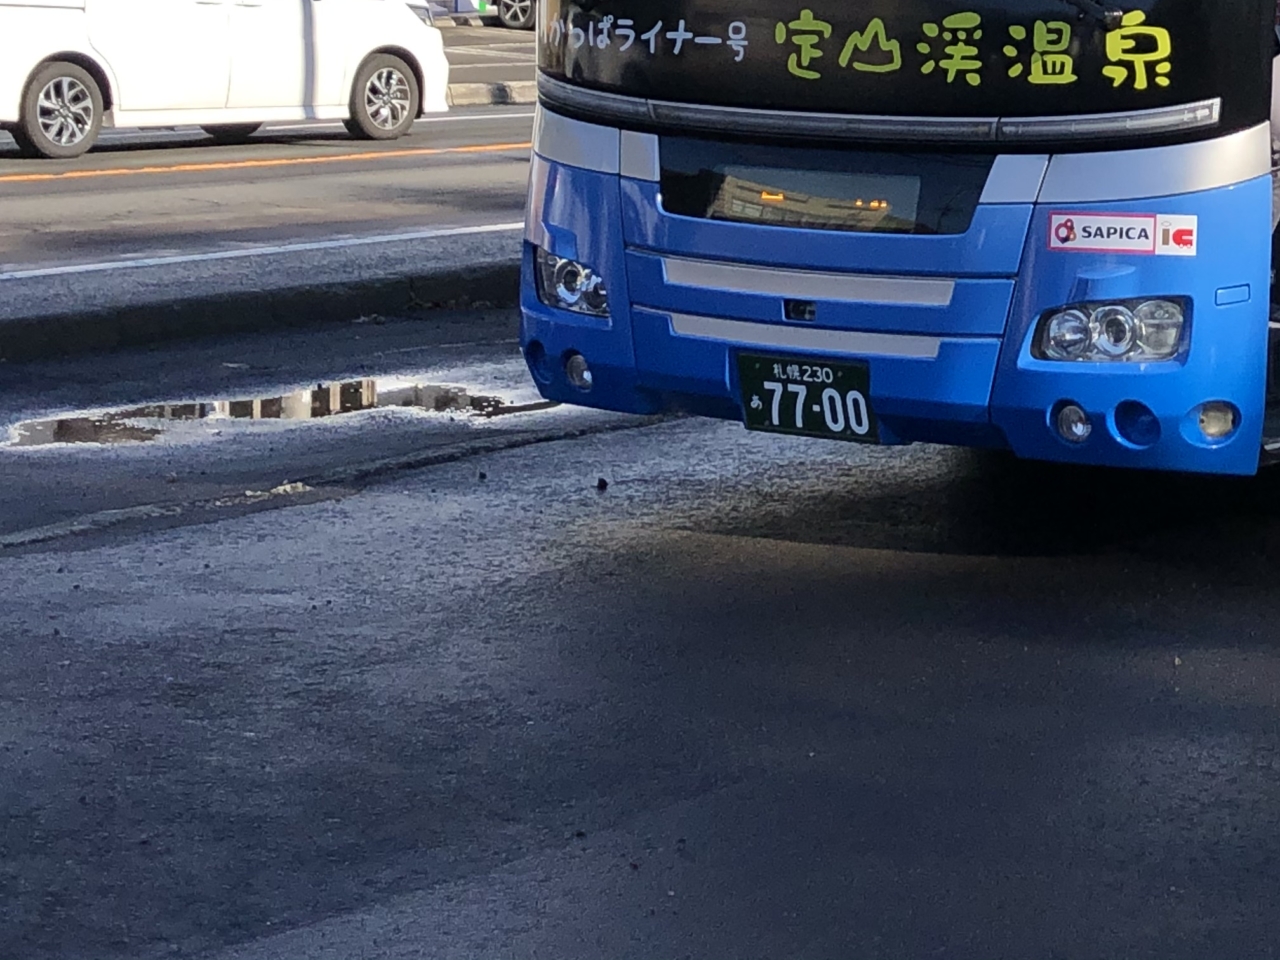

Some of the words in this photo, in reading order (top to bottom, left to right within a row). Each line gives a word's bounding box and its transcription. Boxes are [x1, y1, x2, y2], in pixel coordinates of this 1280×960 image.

[546, 13, 749, 62] かっぱライナー号
[775, 9, 1172, 89] 定山渓温泉
[1081, 225, 1150, 240] SAPICA
[763, 381, 869, 435] 77-00
